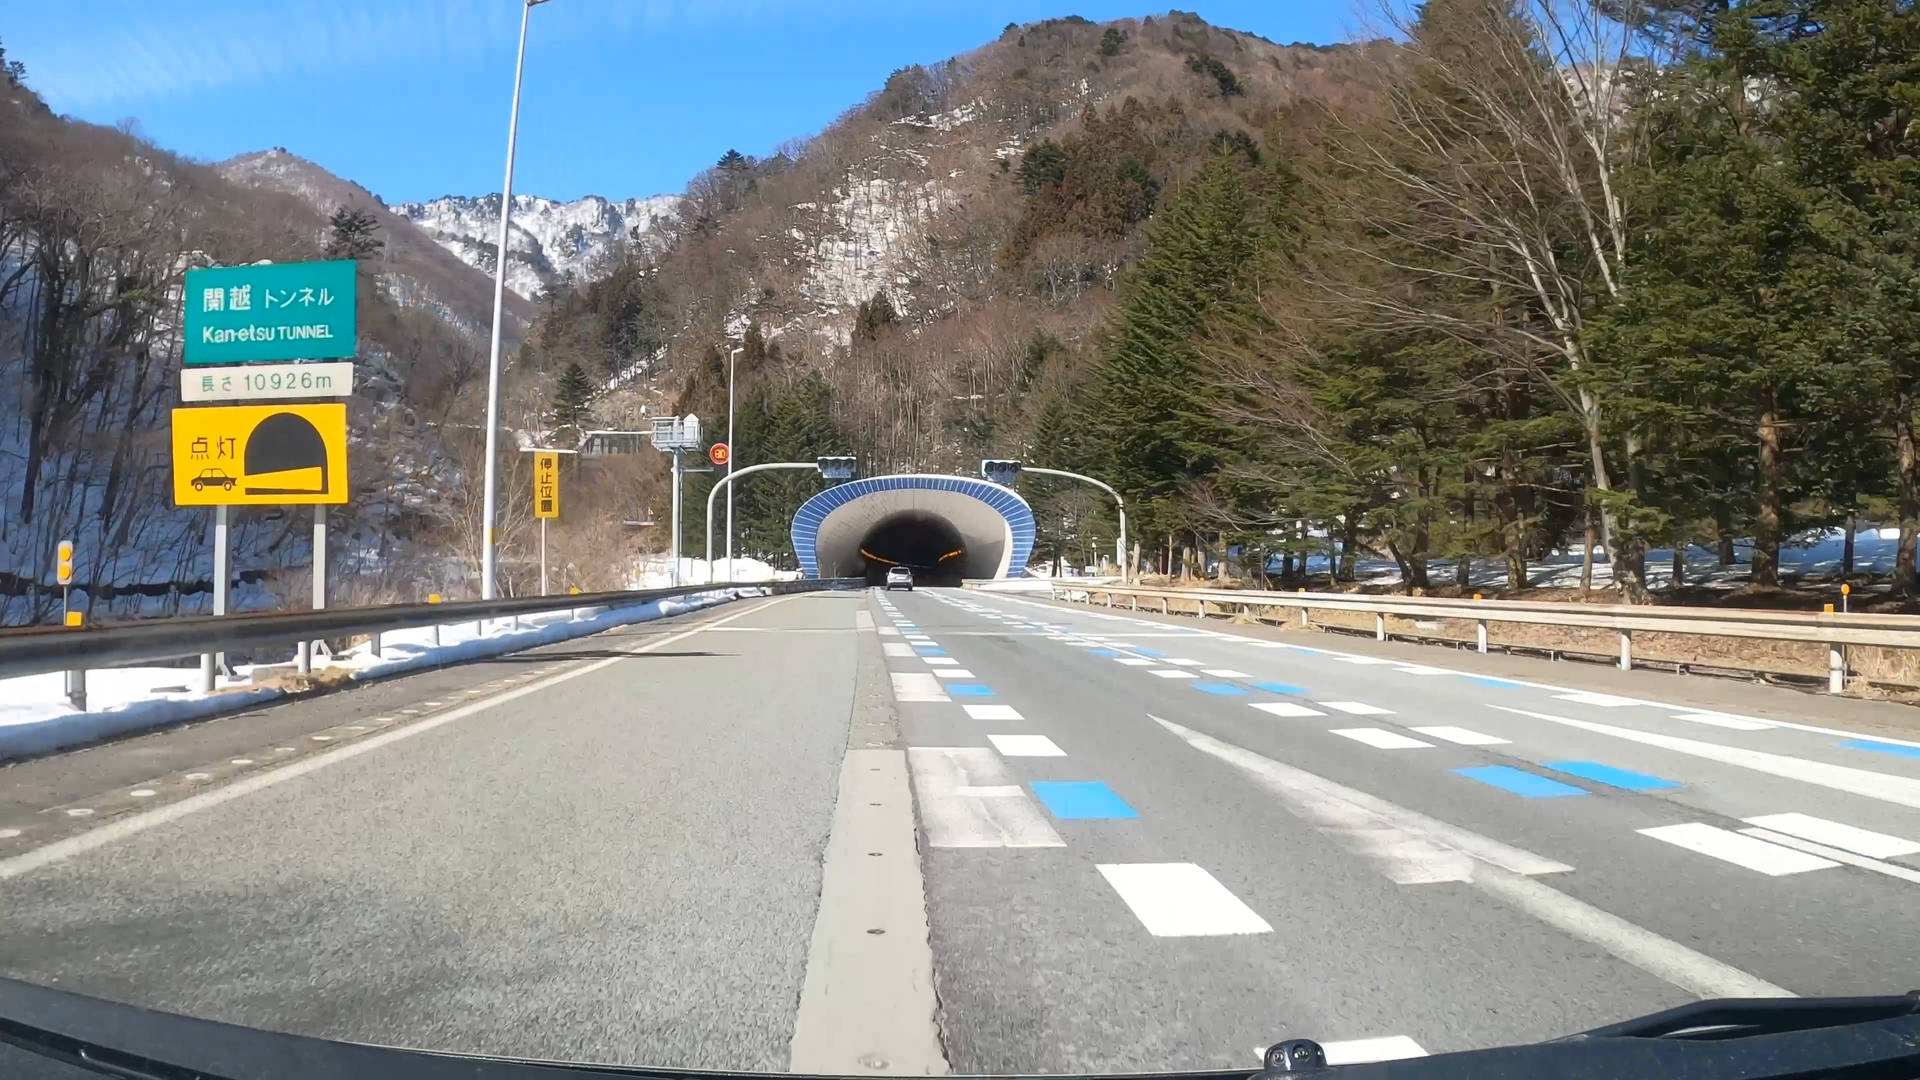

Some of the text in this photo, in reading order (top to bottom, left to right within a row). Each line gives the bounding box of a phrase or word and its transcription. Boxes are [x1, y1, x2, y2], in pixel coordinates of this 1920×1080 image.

[203, 285, 334, 312] 関越 トンネル
[202, 324, 334, 344] Kan-etsu TUNNEL
[243, 372, 332, 390] 10926m
[190, 435, 236, 460] 点灯
